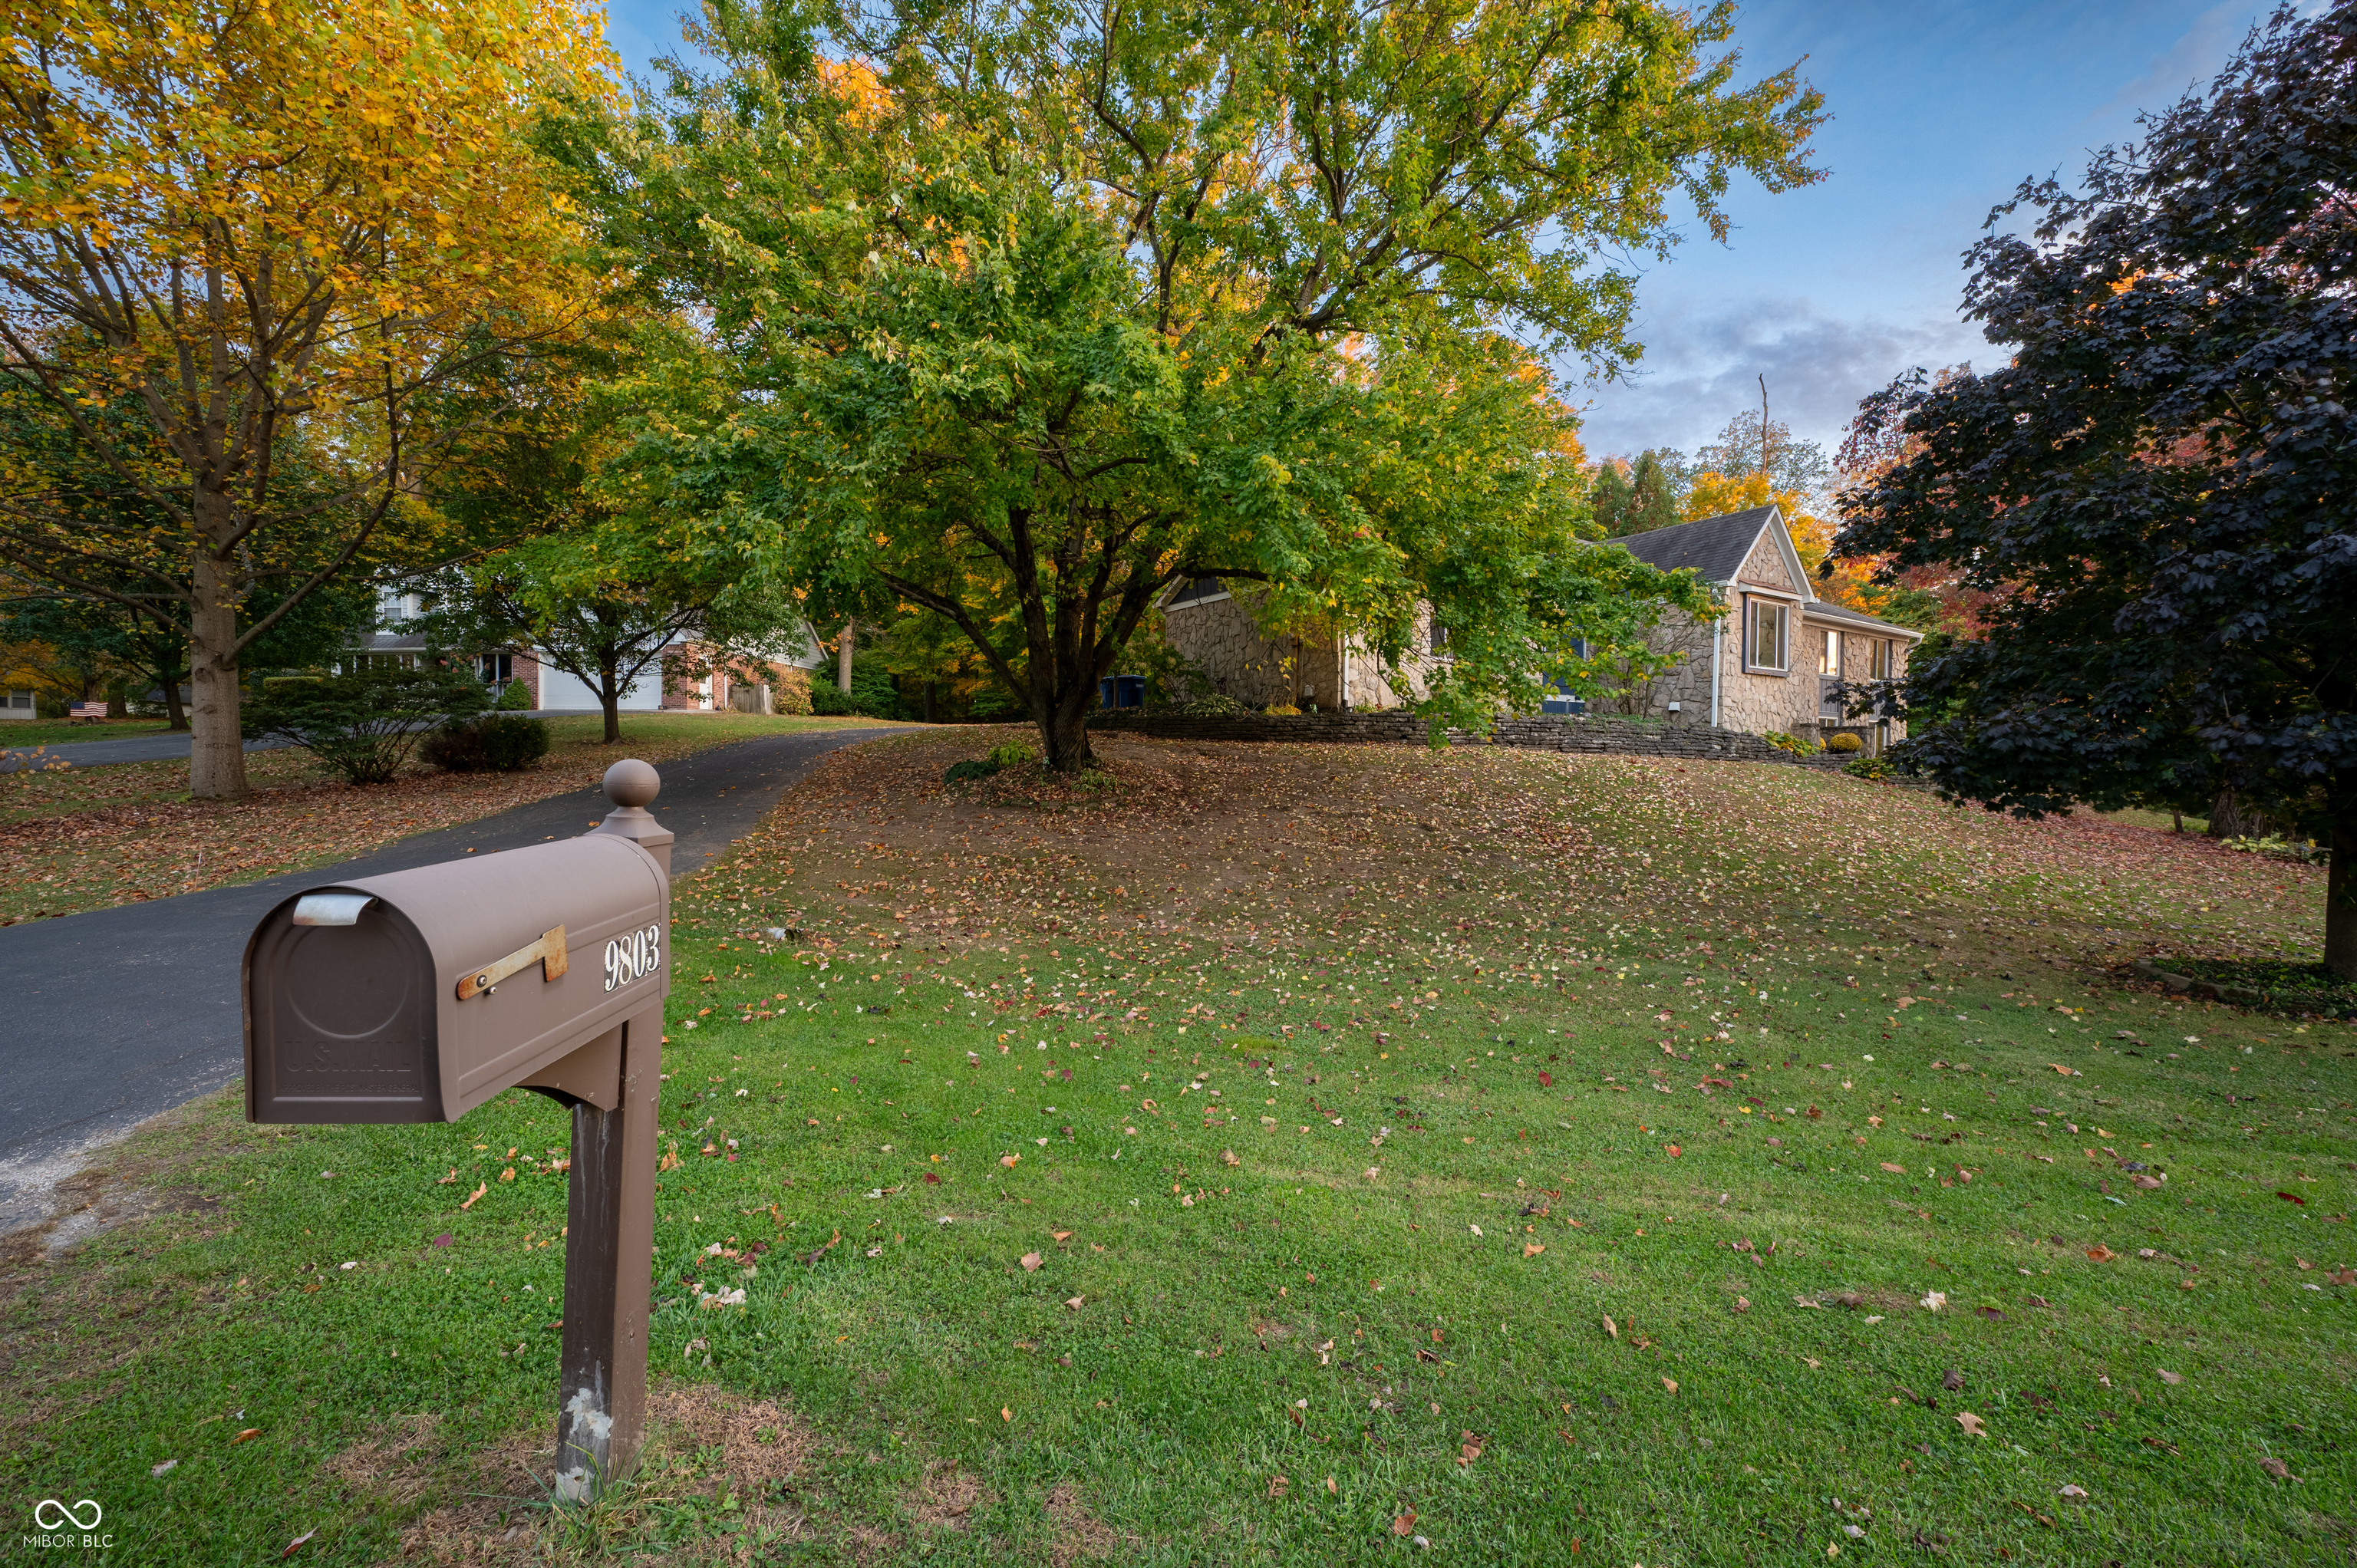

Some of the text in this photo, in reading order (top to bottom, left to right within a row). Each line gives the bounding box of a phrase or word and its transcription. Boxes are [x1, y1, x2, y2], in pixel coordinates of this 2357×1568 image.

[605, 924, 660, 991] 9803
[285, 1041, 411, 1072] U.S. MAIL
[279, 1083, 420, 1092] APPROVED BY THE POSTMASTER GENERAL
